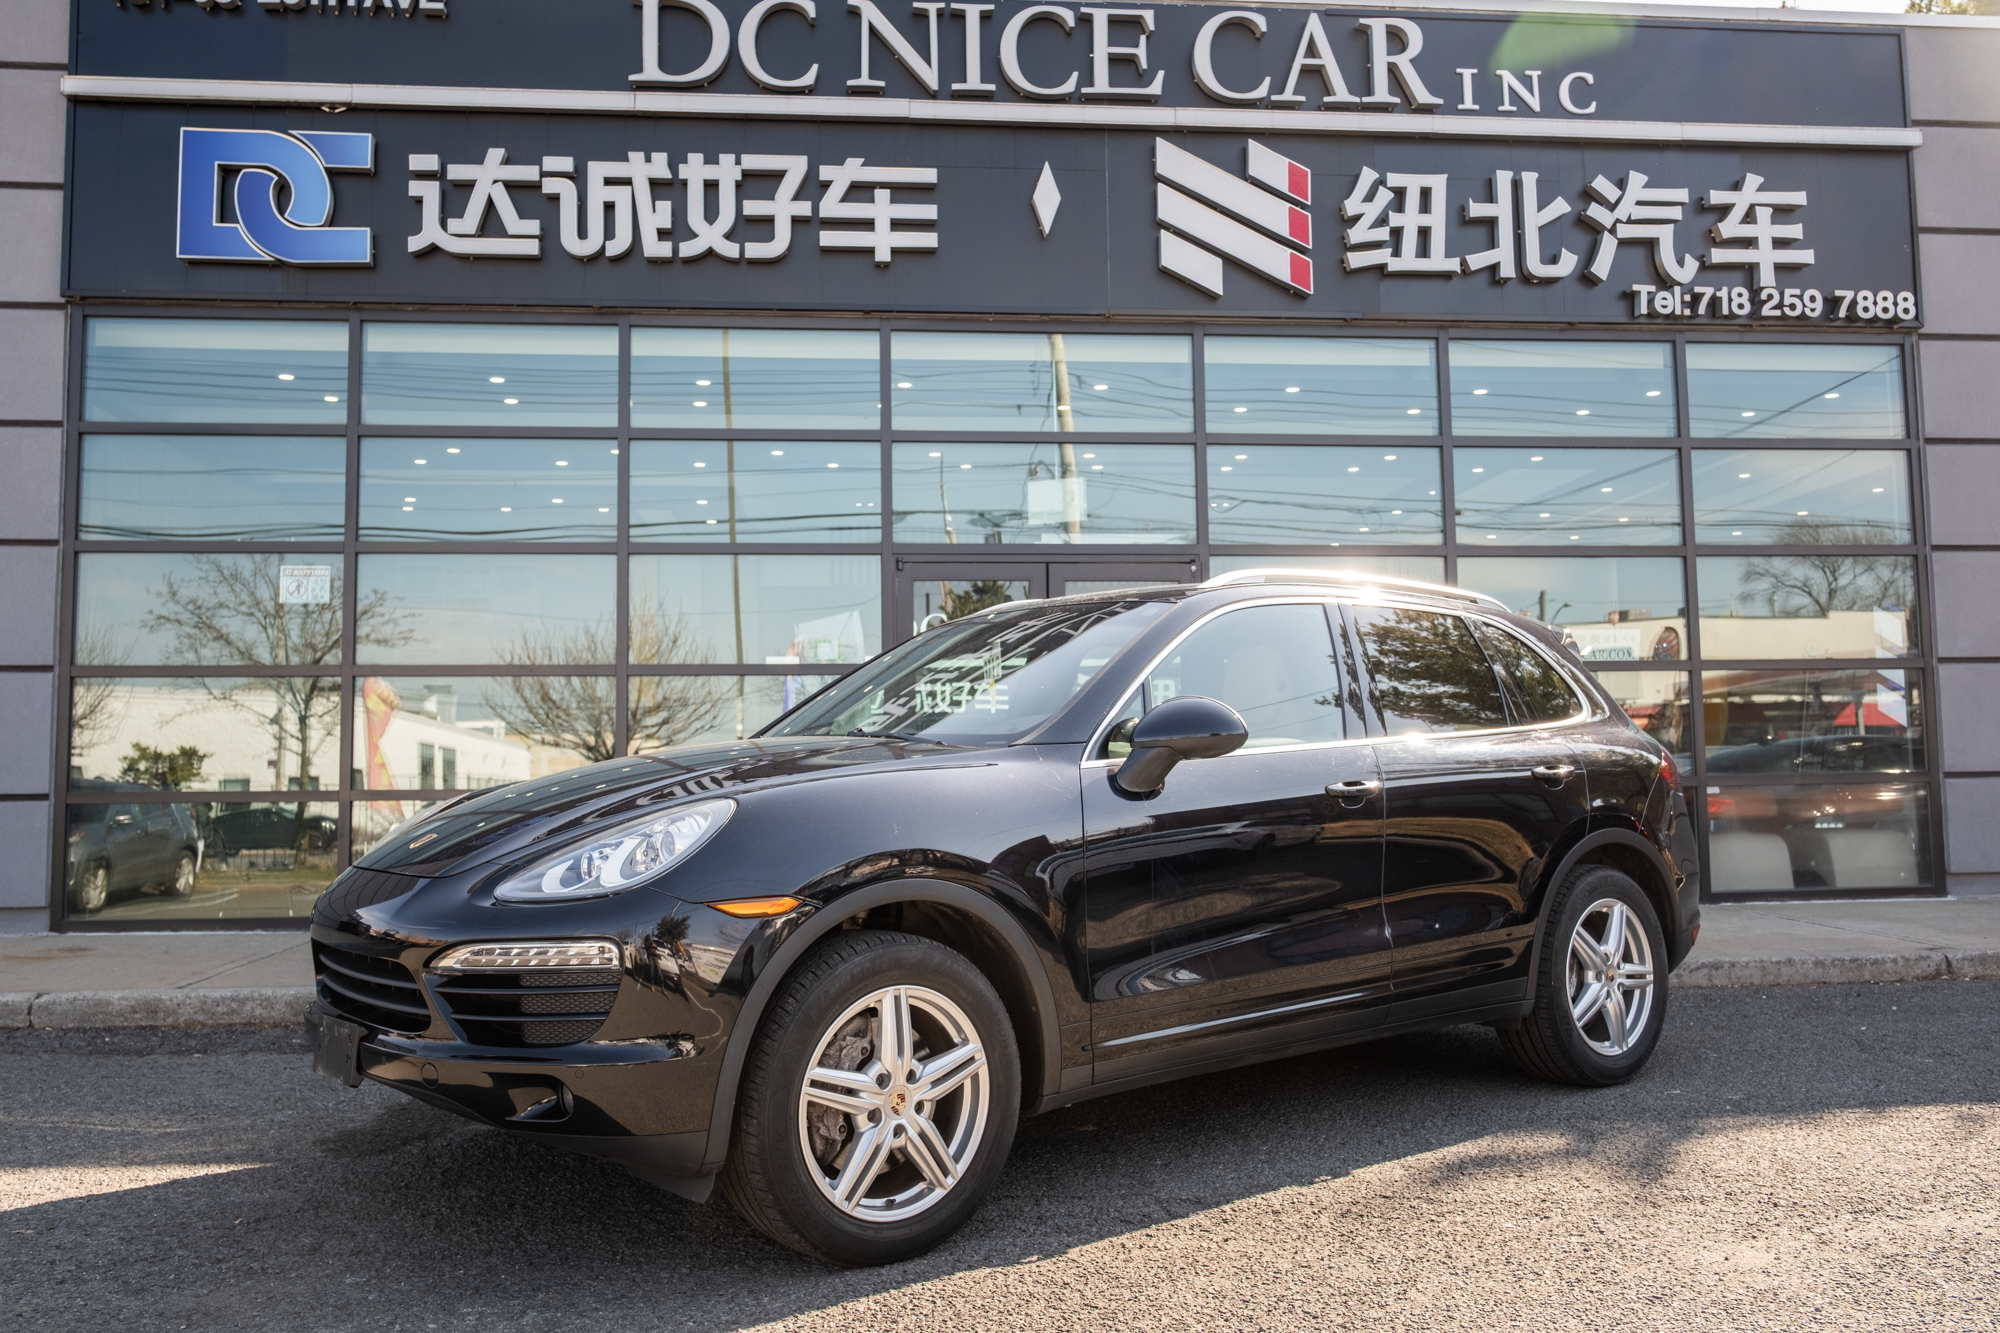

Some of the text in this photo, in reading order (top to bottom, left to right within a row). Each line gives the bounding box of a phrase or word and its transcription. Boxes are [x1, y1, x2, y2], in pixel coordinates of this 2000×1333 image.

[628, 0, 1598, 115] DC NICE CAR INC
[177, 127, 375, 267] DC
[407, 147, 939, 266] 达诚好车
[1342, 166, 1815, 287] 纽北汽车
[1760, 287, 1824, 317] 259
[1834, 289, 1917, 321] 7888
